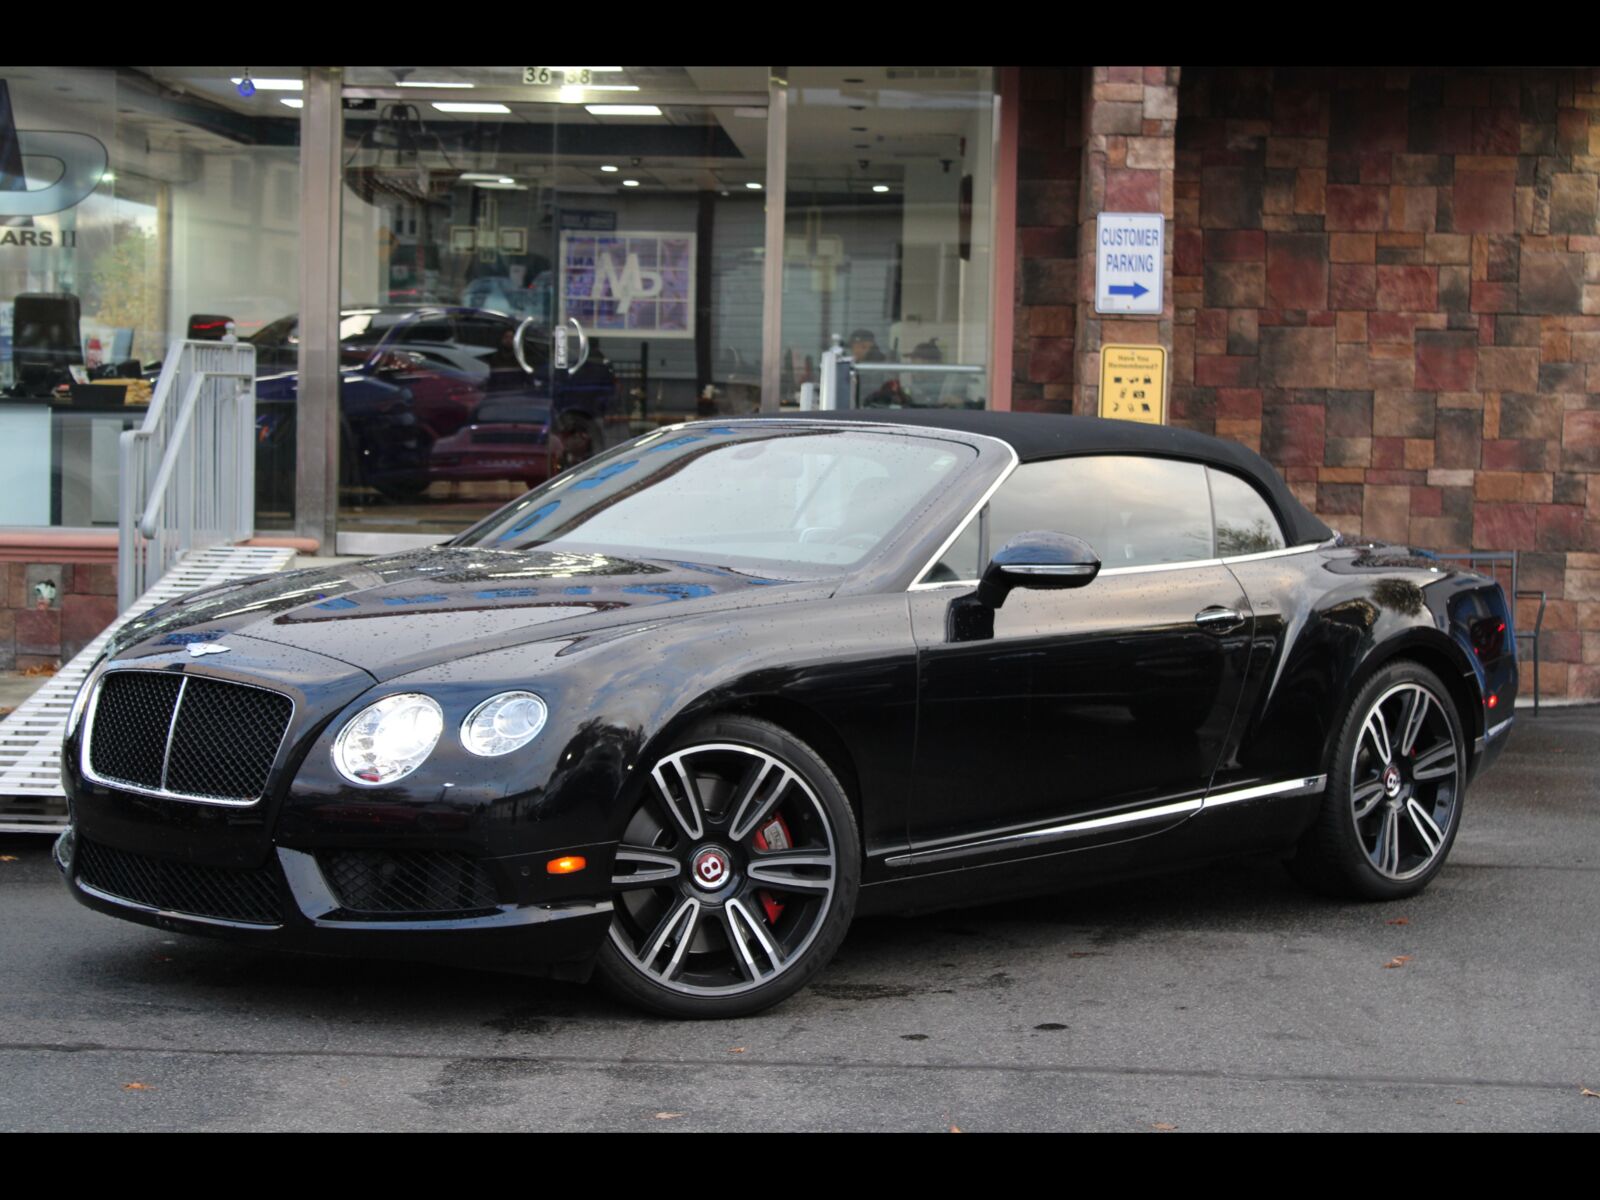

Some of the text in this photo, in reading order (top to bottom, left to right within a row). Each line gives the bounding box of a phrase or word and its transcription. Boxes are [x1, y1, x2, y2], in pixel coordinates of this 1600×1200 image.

[526, 67, 549, 83] 36
[1101, 228, 1159, 246] CUSTOMER
[1106, 254, 1153, 272] PARKING
[701, 857, 721, 879] B
